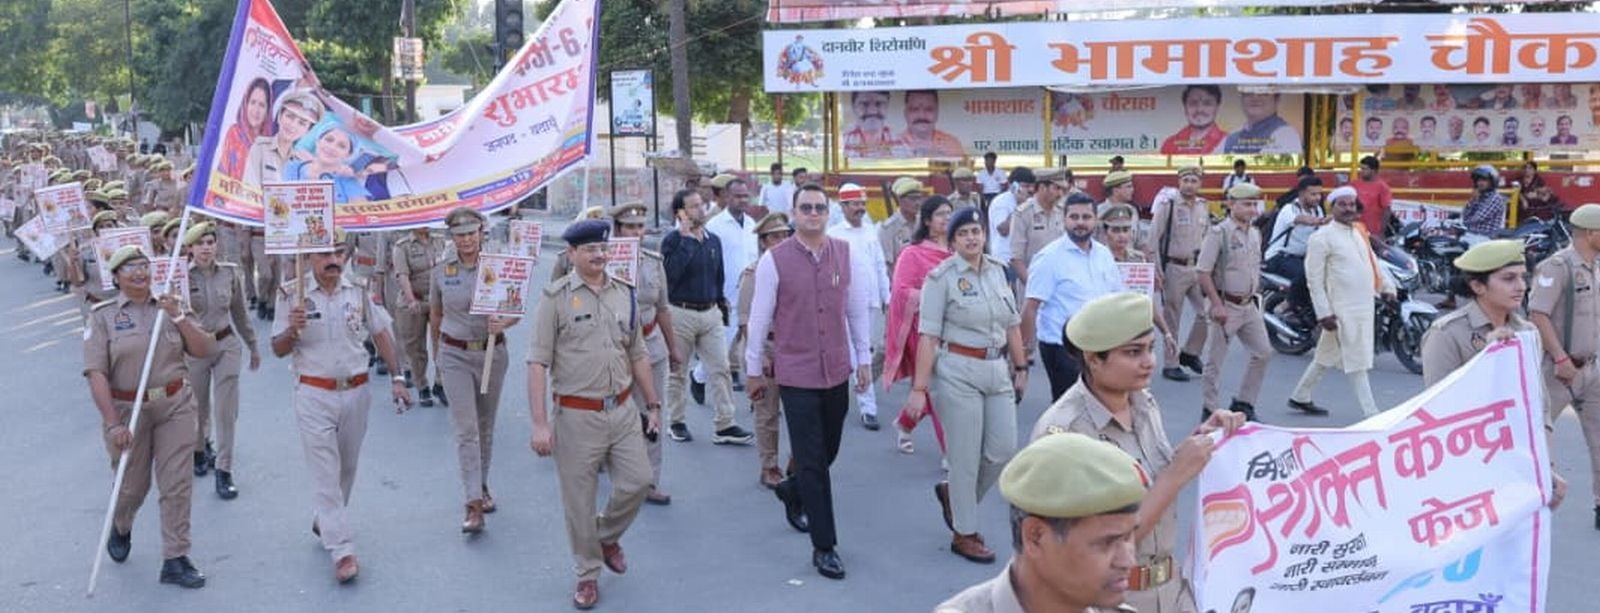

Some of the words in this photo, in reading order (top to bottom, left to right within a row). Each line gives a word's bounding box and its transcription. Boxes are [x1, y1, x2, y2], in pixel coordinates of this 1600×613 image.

[822, 38, 865, 53] दानवीर
[869, 36, 926, 52] शिरोमणि
[928, 31, 1015, 82] श्री
[1048, 35, 1398, 81] भामाशाह
[1426, 17, 1600, 75] चौक
[963, 99, 1036, 115] भामाशाह
[973, 139, 991, 151] पर
[998, 139, 1039, 152] आपका
[1049, 136, 1084, 151] ार्दिक
[1089, 137, 1134, 150] स्वागत
[1388, 398, 1515, 479] केन्द्र
[1408, 489, 1499, 548] फेज
[1289, 540, 1331, 555] नारी
[1283, 557, 1318, 578] नारी
